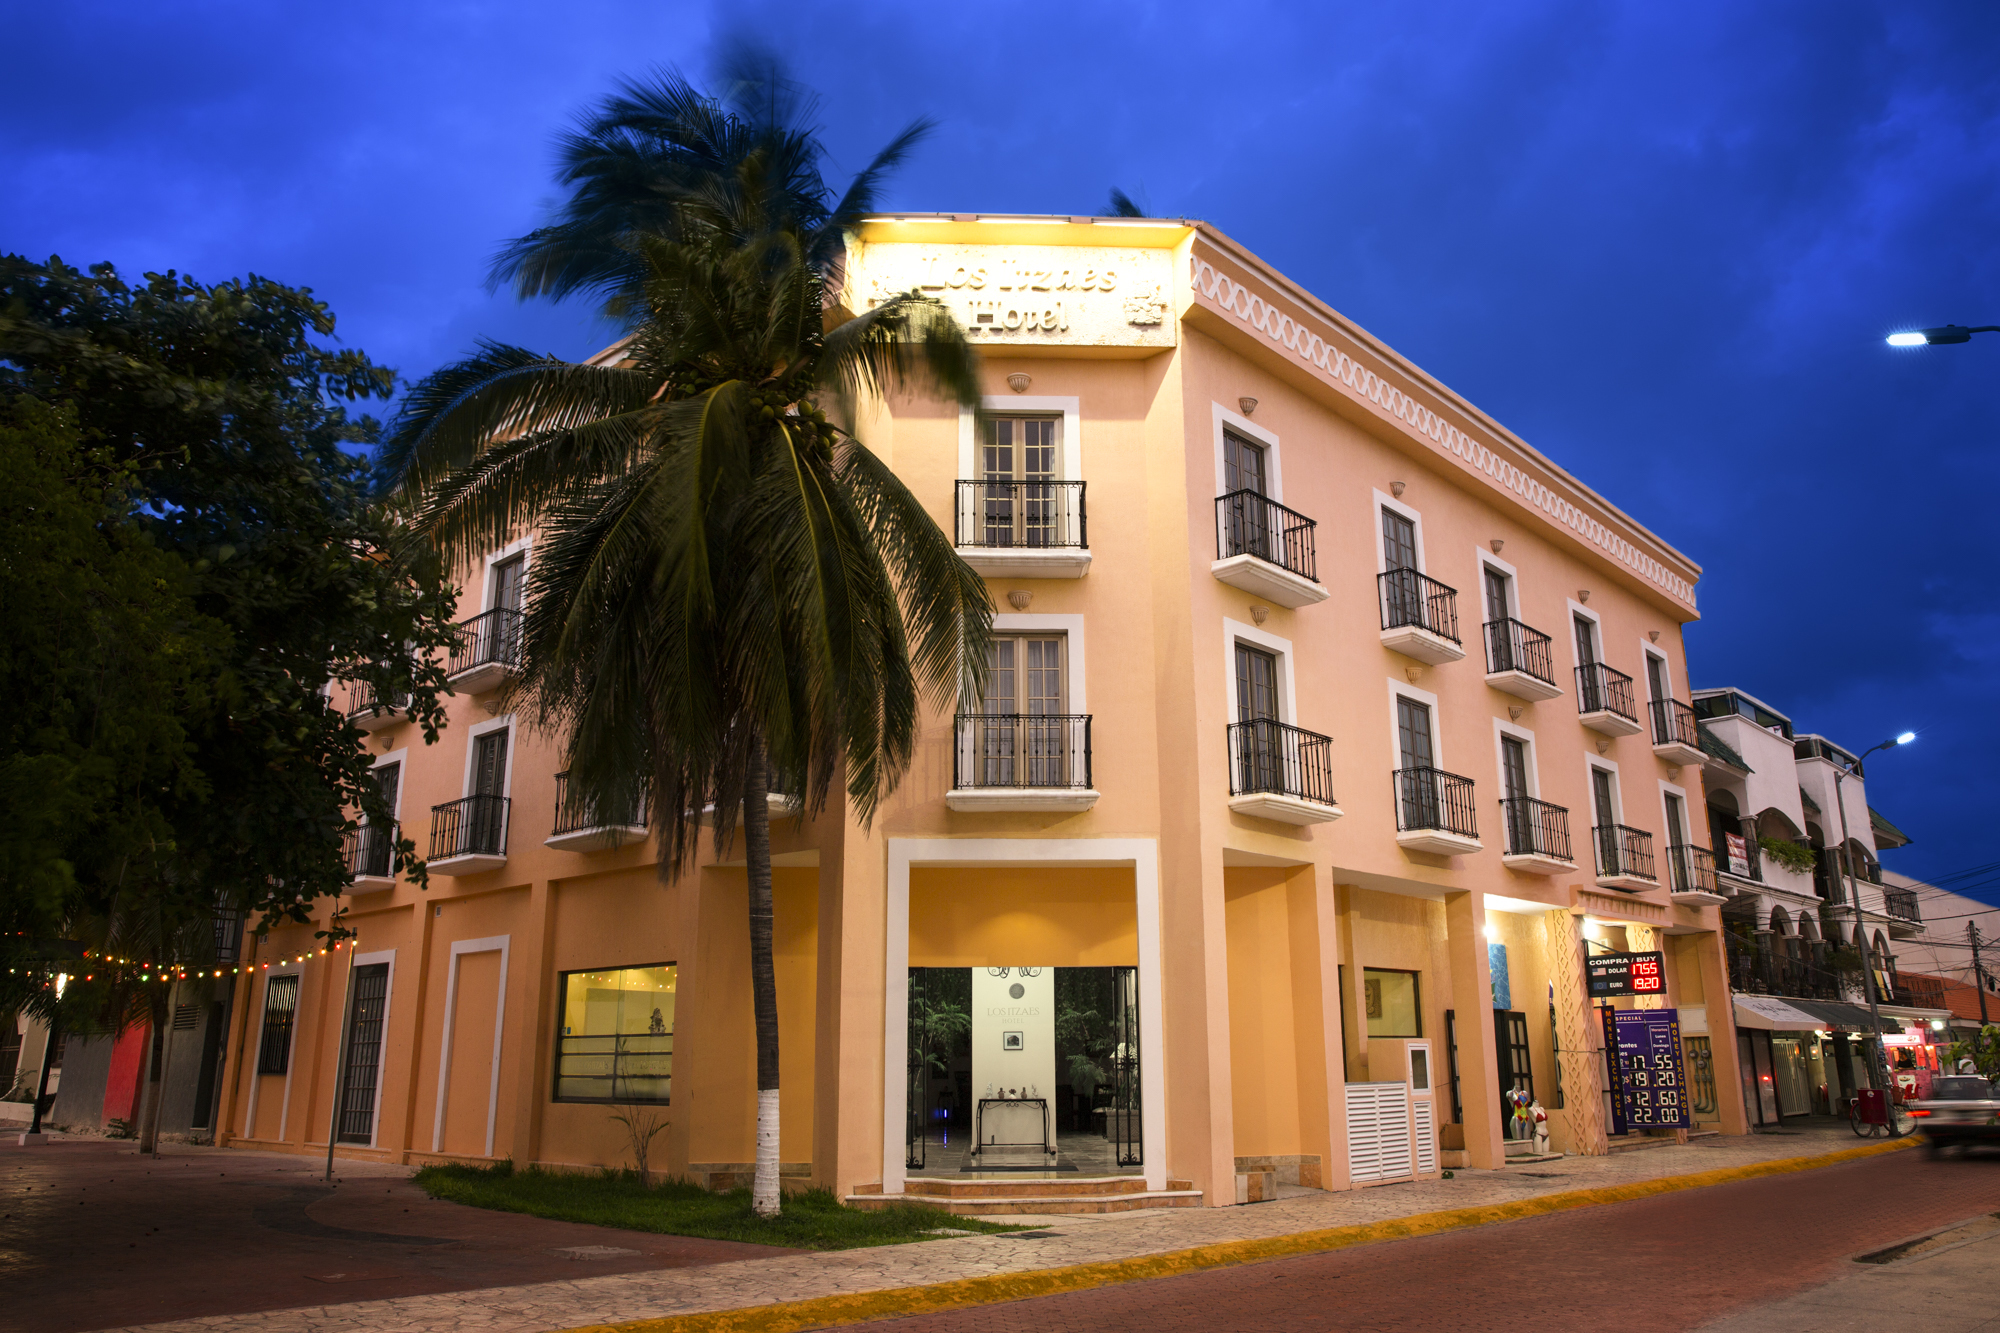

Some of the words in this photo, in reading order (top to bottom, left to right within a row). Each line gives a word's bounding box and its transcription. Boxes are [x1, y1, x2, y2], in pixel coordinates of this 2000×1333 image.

[921, 257, 987, 291] Los
[968, 300, 1069, 332] Hotel
[1589, 958, 1629, 966] COMPRA
[987, 1007, 1006, 1016] LOS
[1008, 1007, 1040, 1016] ITZAES
[1605, 1010, 1613, 1047] MONEY
[1671, 1022, 1680, 1057] MONEY
[1611, 1053, 1621, 1116] EXCHANGE
[1676, 1059, 1687, 1116] EXCHANGE
